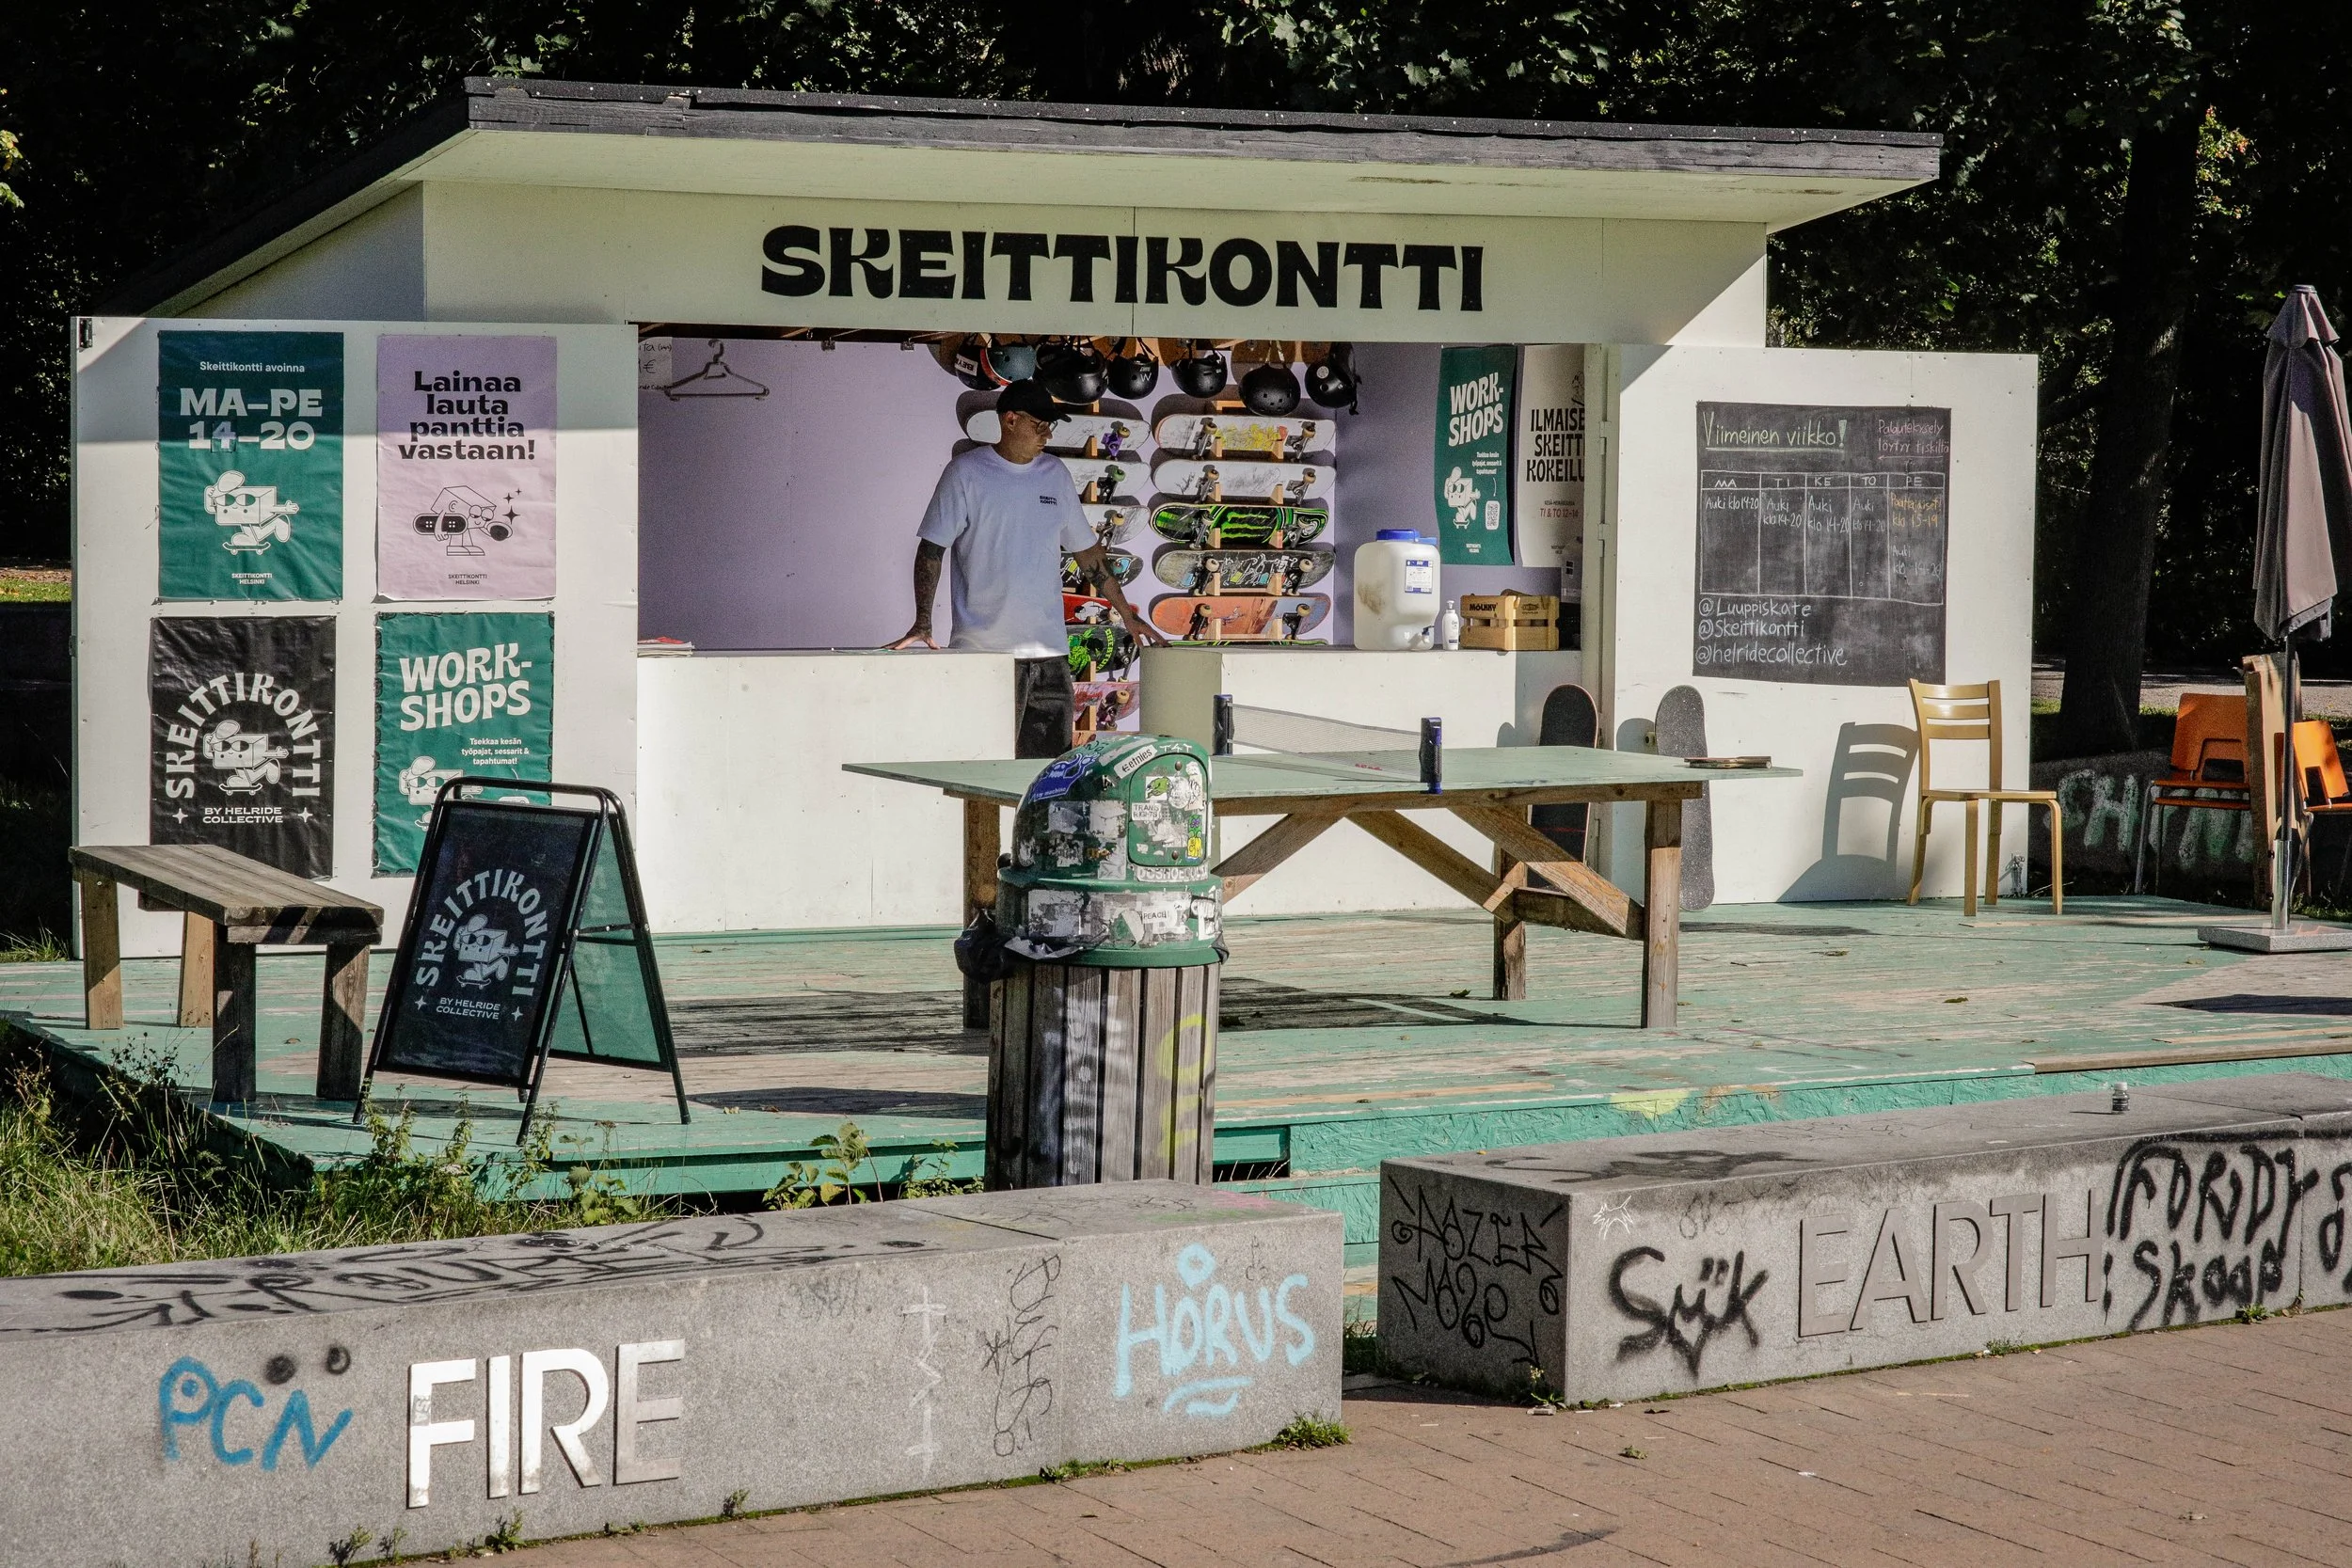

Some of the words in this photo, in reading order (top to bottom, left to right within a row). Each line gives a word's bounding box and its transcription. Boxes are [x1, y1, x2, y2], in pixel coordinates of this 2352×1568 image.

[761, 224, 1485, 311] SKEITTIKONTTI
[199, 361, 263, 372] Skeittikontti
[265, 362, 306, 372] avoinna
[414, 370, 522, 392] Lainaa
[1450, 372, 1504, 416] WORK-
[426, 393, 509, 415] lauta
[409, 416, 525, 442] panttia
[1448, 403, 1503, 447] SHOPS
[1703, 411, 1780, 447] Viimeinen
[1787, 419, 1848, 449] viikko!
[398, 439, 535, 460] vastaan!
[1714, 479, 1738, 488] MA
[1773, 478, 1790, 488] TI
[1814, 476, 1833, 487] KE
[1862, 476, 1877, 486] TO
[1905, 475, 1923, 487] PE
[1705, 495, 1726, 511] Auki
[1766, 497, 1789, 514] Auki
[1808, 494, 1833, 514] Auki
[1852, 496, 1875, 513] Auki
[1807, 516, 1822, 531] klo
[1698, 618, 1805, 641] @Skeittikontti
[1695, 641, 1849, 666] @helridecollective
[399, 642, 532, 693] WORK-
[400, 679, 532, 732] SHOPS
[165, 672, 321, 799] SKEITTIKONTTI
[461, 747, 493, 756] työpajat,
[1128, 749, 1152, 768] etnies
[472, 757, 517, 766] tapahtumat!
[202, 816, 284, 824] COLLECTIVE
[204, 807, 220, 816] BY
[225, 807, 282, 816] HELRIDE
[416, 868, 548, 997] SKEITTIKONTTI
[436, 1006, 501, 1020] COLLECTIVE
[439, 997, 454, 1006] BY
[455, 998, 501, 1011] HELRIDE
[1798, 1187, 2104, 1338] EARTH
[407, 1338, 686, 1509] FIRE
